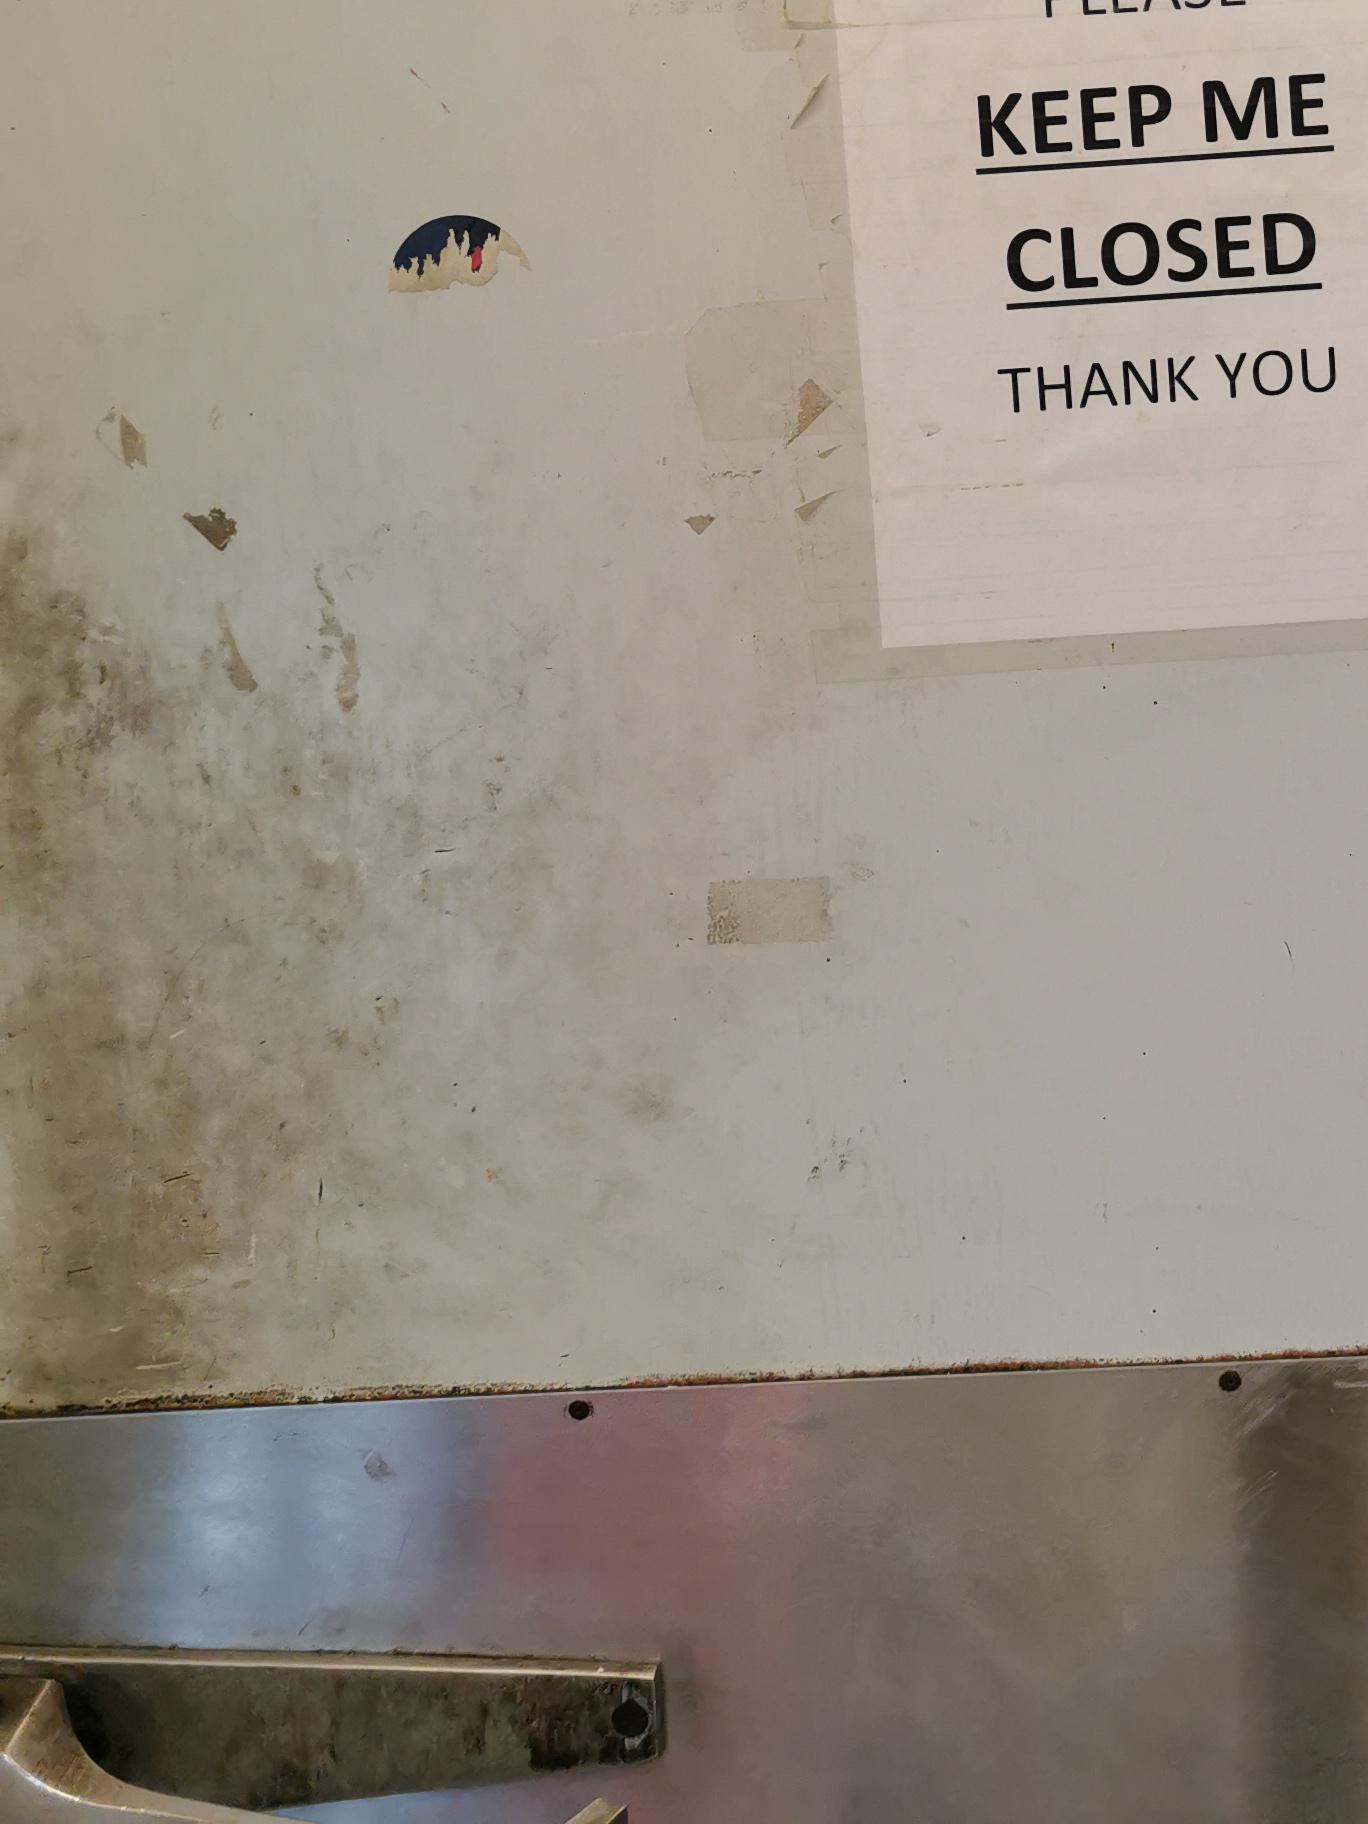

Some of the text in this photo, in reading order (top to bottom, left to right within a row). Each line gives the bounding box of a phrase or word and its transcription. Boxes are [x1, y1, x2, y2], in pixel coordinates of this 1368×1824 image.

[976, 73, 1329, 158] KEEP ME
[1006, 212, 1317, 293] CLOSED
[997, 346, 1337, 413] THANK YOU
